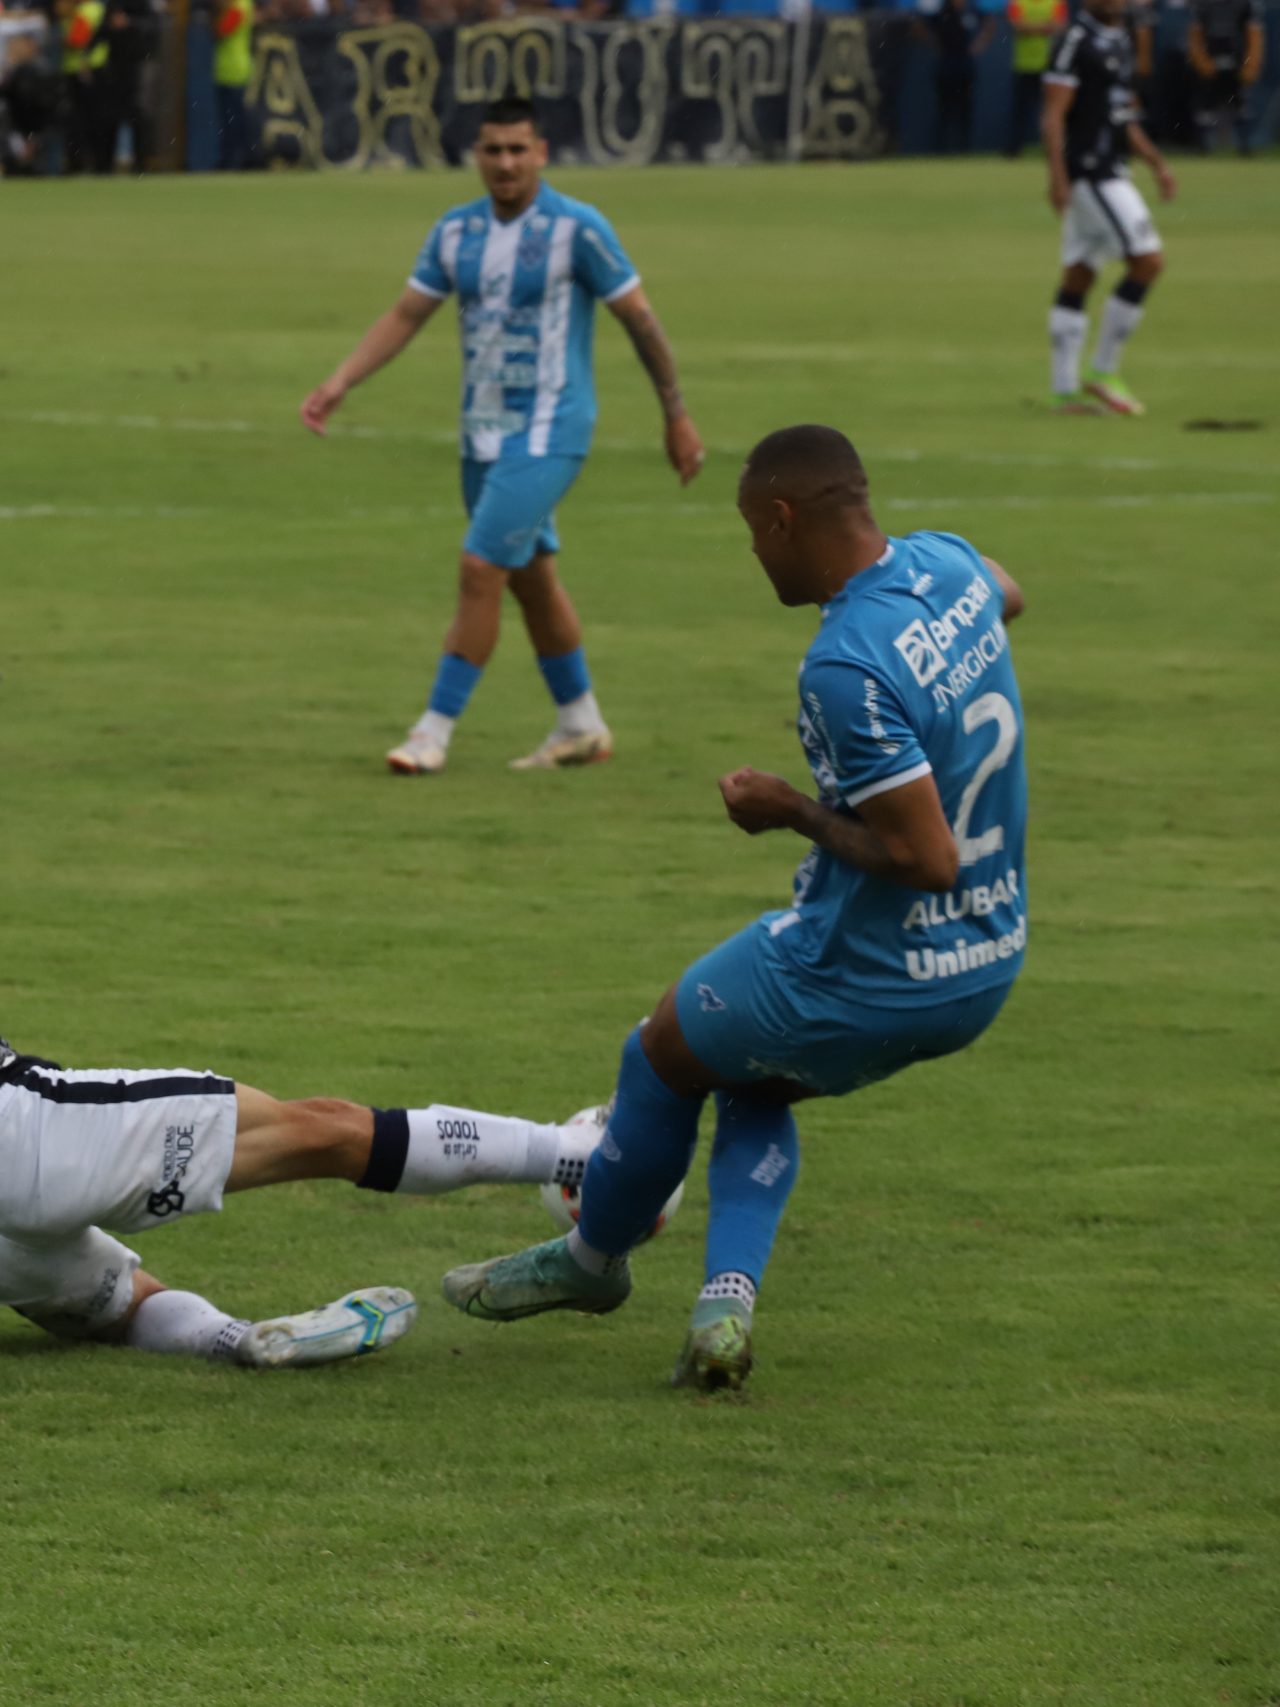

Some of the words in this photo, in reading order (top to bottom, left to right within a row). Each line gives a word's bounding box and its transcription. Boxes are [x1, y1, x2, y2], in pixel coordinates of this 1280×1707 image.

[952, 692, 1020, 866] 2
[905, 915, 1026, 980] Unimed
[436, 1120, 480, 1140] TODOS
